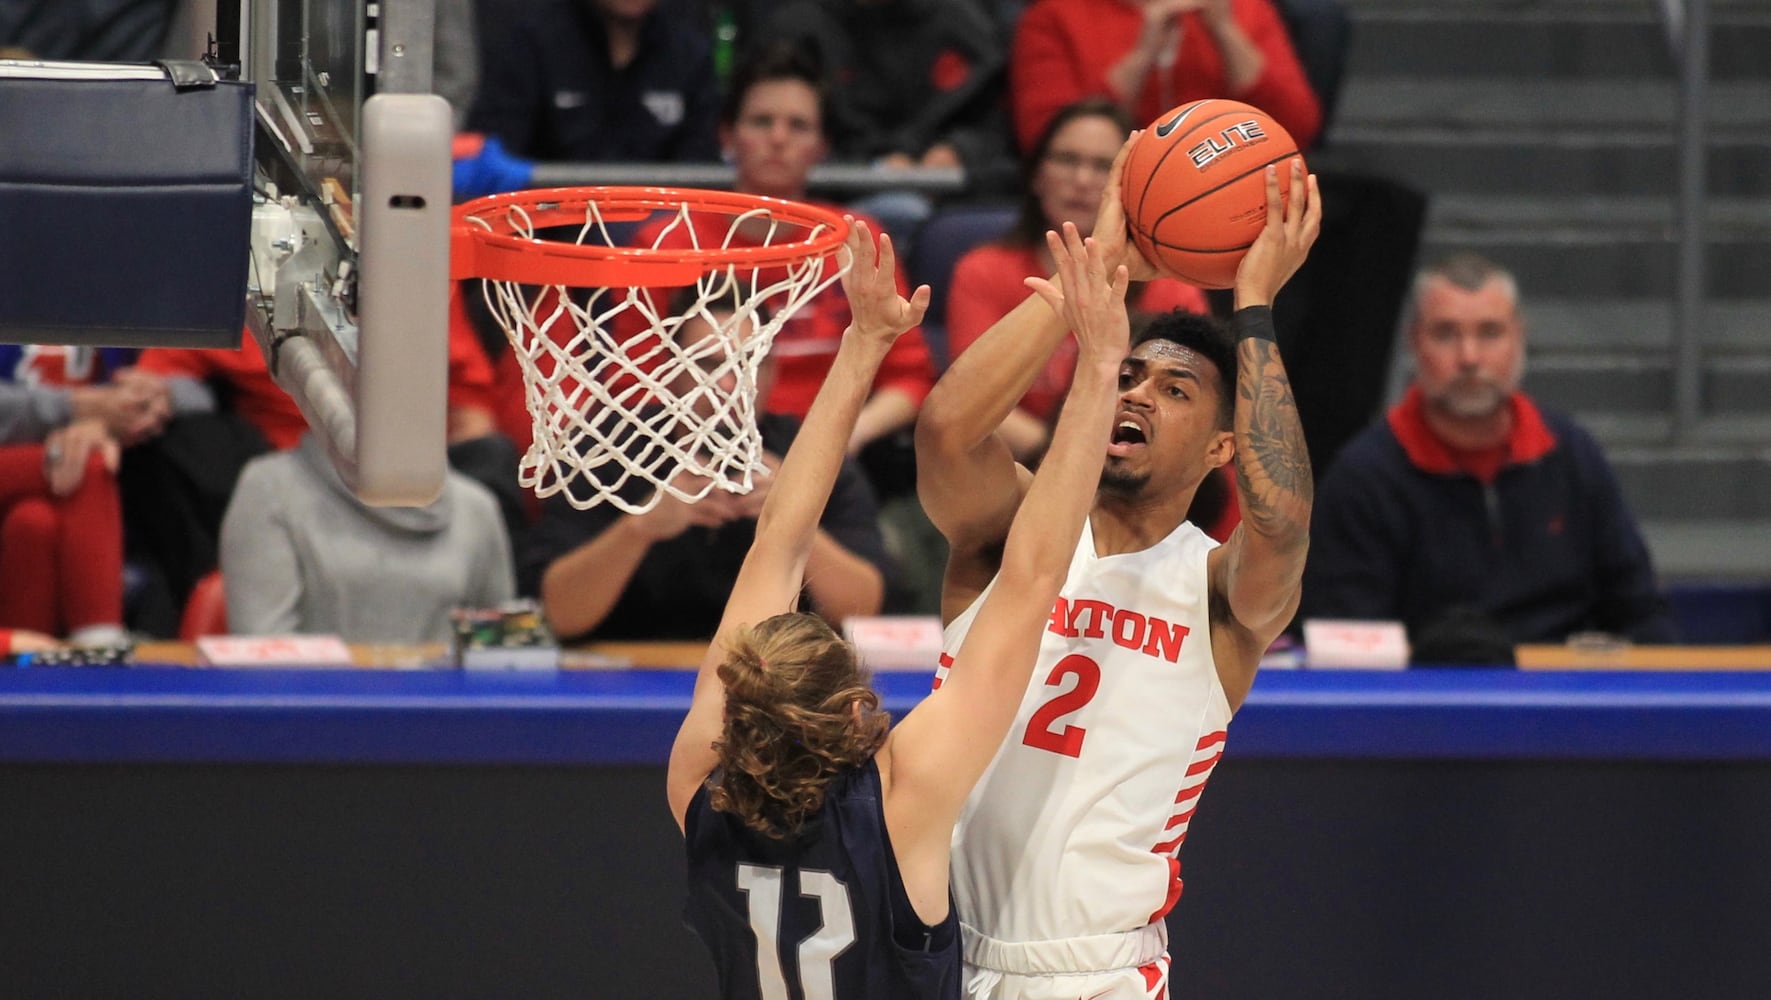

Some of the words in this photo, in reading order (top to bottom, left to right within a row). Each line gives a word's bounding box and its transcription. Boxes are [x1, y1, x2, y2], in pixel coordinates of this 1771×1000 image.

[1187, 120, 1267, 168] ELITE
[1048, 596, 1190, 664] AYTON
[1022, 653, 1101, 759] 2
[735, 861, 858, 1000] 12
